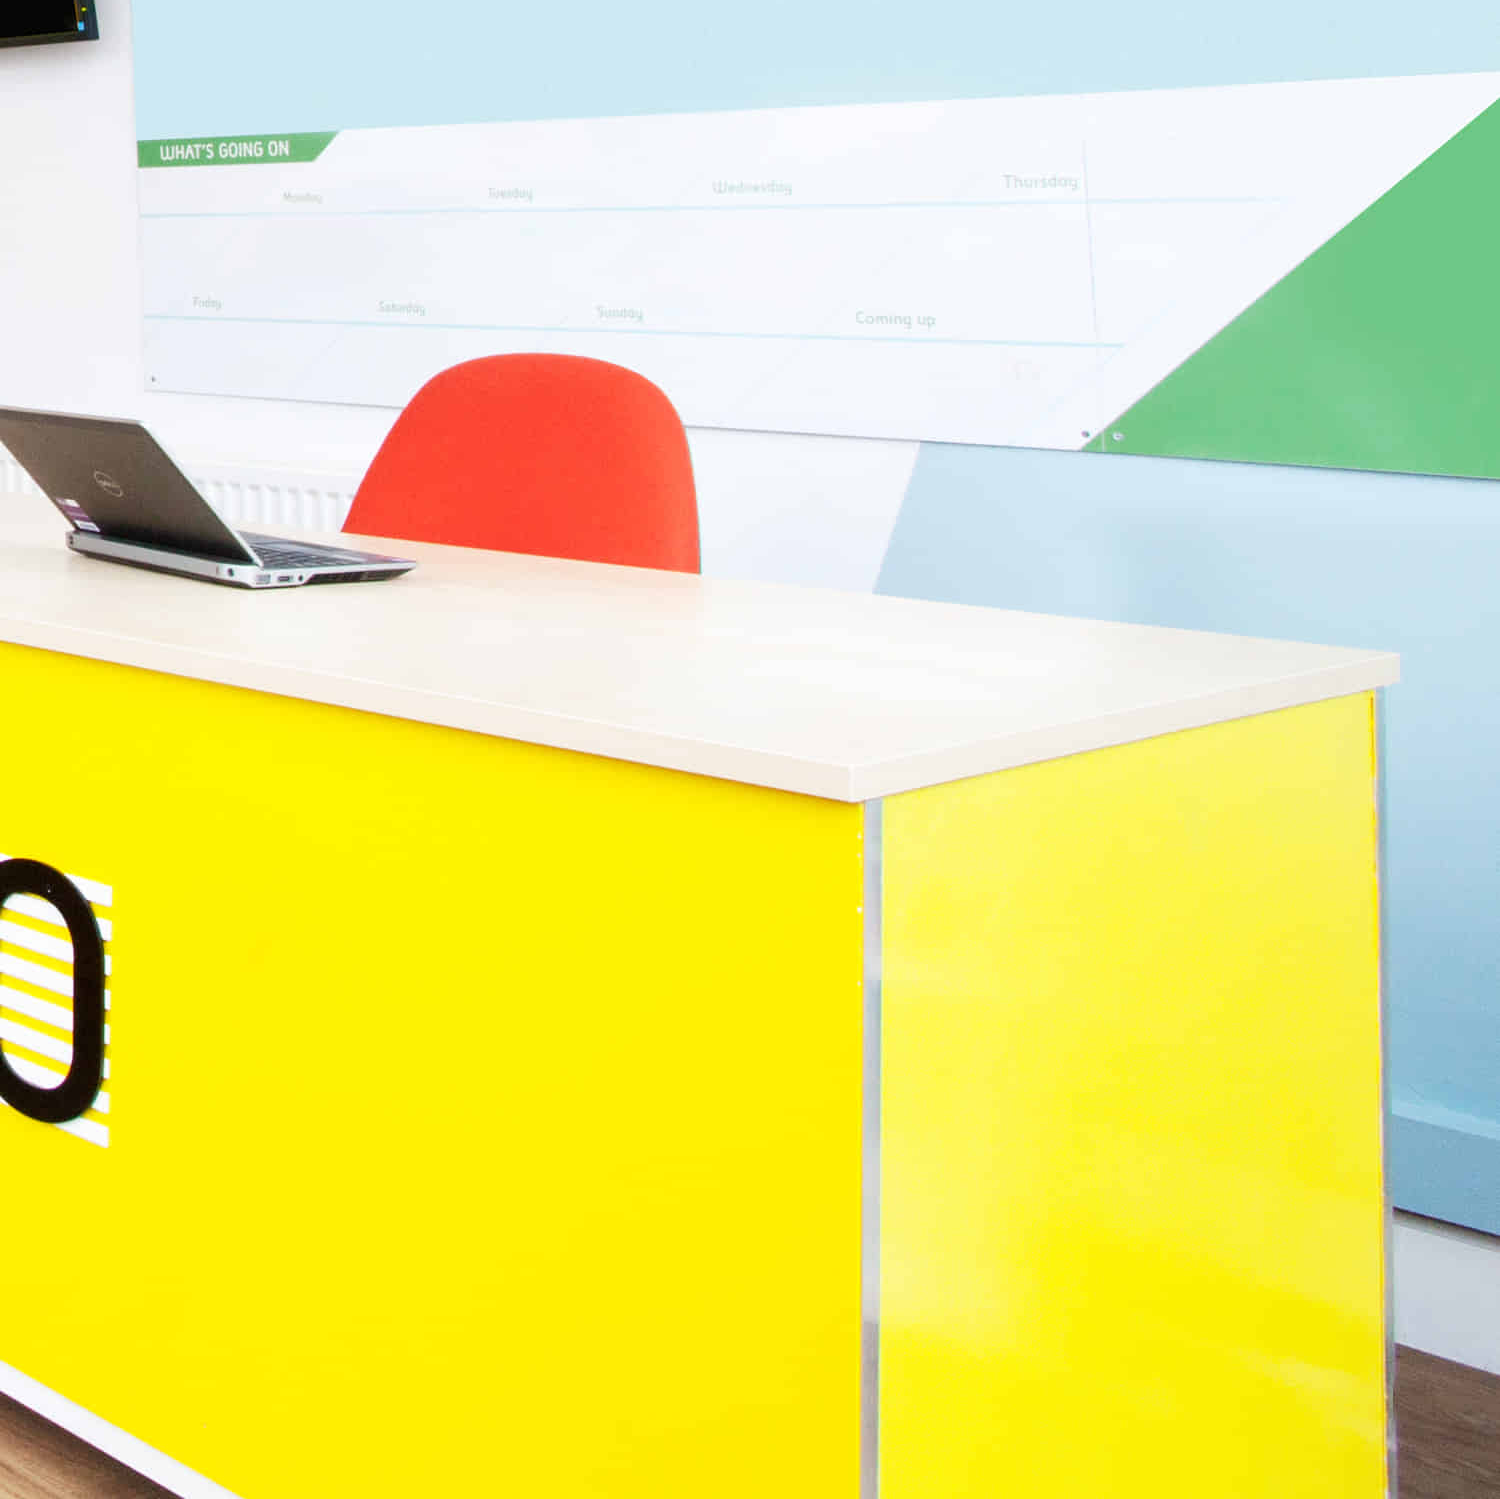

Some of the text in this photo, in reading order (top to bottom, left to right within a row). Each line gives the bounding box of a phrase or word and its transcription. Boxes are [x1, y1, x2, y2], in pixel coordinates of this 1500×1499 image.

[159, 140, 290, 161] WHAT'S GOING ON
[712, 179, 793, 197] Wednesday
[1002, 174, 1081, 192] Thursday
[487, 186, 534, 202] Tuesday
[192, 296, 223, 311] Friday
[376, 300, 426, 316] Saturday
[595, 305, 644, 322] Sunday
[855, 311, 937, 329] Coming up
